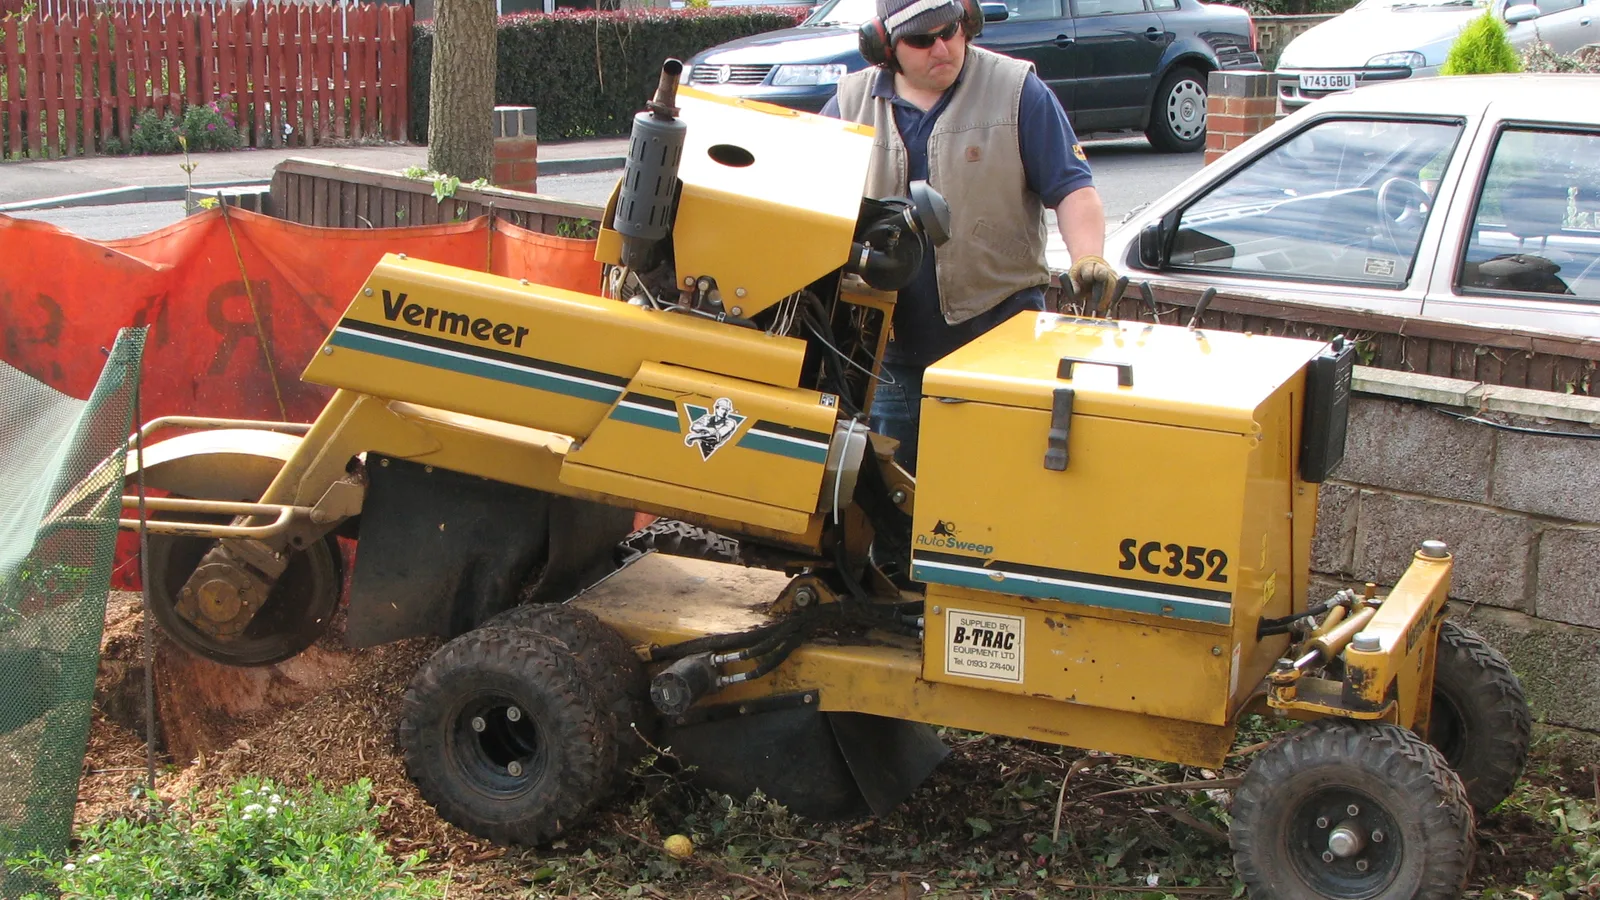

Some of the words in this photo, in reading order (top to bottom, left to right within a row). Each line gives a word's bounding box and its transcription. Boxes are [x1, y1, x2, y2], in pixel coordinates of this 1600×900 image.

[1303, 75, 1327, 87] V743
[1329, 75, 1350, 87] GBU
[382, 289, 529, 348] Vermeer
[1119, 538, 1228, 583] SC352
[960, 618, 997, 630] SUPPLIED
[999, 622, 1010, 632] BY
[953, 626, 1015, 650] B-TRAC
[953, 645, 999, 658] EQUIPMENT
[1001, 651, 1015, 660] LTD
[966, 659, 988, 669] 01933
